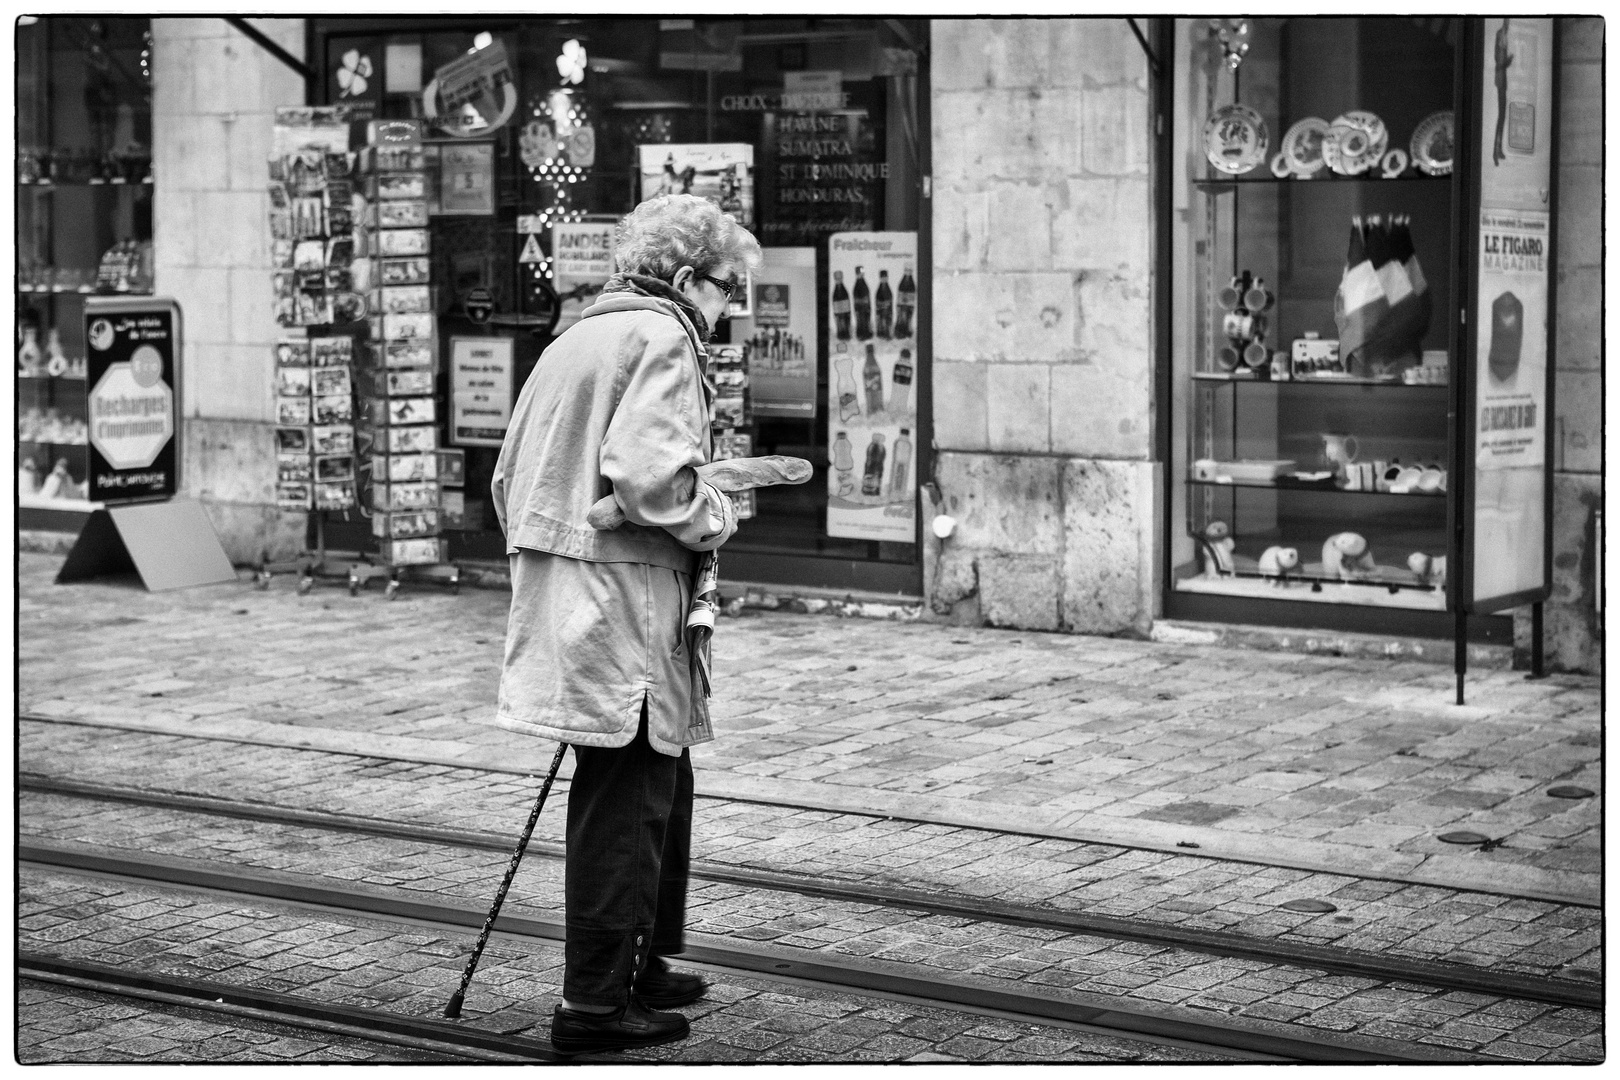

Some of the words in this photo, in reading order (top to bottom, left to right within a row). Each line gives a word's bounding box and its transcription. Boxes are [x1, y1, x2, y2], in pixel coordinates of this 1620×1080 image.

[720, 95, 767, 111] CHOIX
[780, 116, 838, 132] HAVANE
[780, 140, 853, 156] SUMATRA
[780, 163, 795, 179] ST
[804, 163, 891, 182] DOMINIQUE
[559, 229, 610, 249] ANDRÉ
[833, 238, 893, 251] Fraîcheur
[1484, 235, 1500, 254] LE
[1502, 235, 1543, 256] FIGARO
[1483, 255, 1544, 272] MAGAZINE
[97, 395, 168, 417] Recharges
